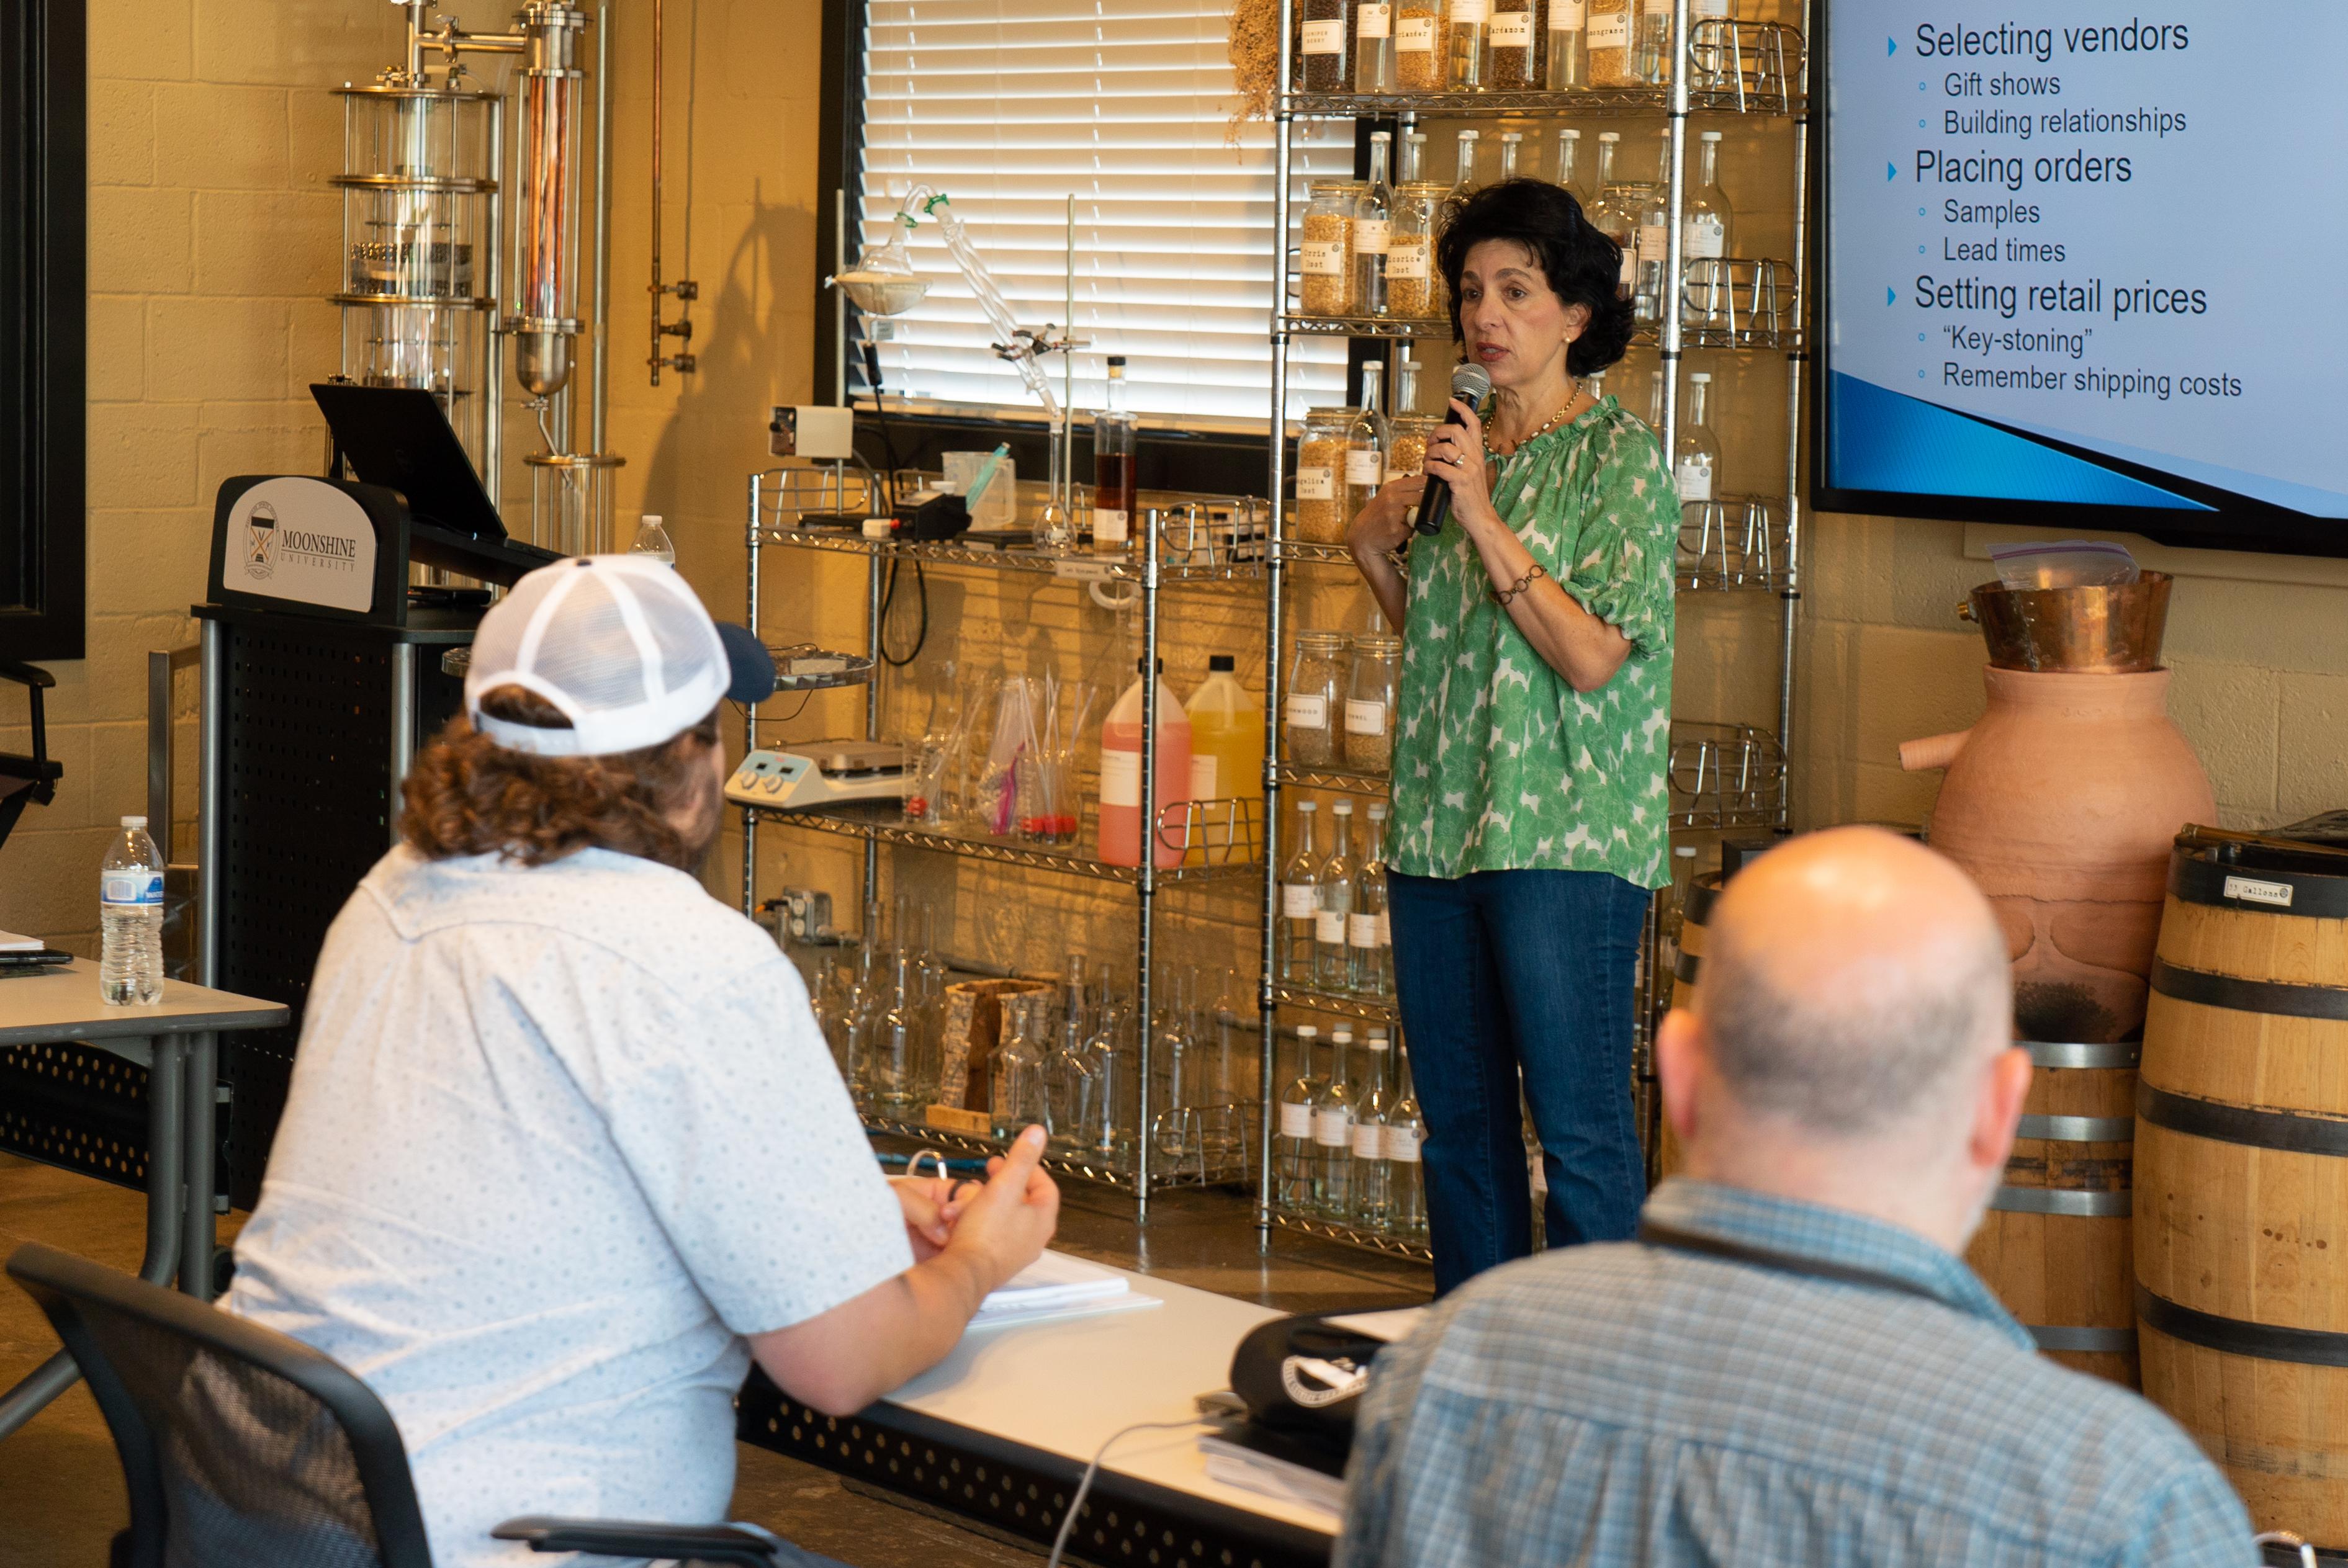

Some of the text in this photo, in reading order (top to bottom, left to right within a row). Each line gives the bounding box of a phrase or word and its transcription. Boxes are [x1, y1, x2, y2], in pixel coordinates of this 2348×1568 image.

[1916, 17, 2189, 63] Selecting vendors
[1945, 71, 2061, 97] Gift shows
[1945, 106, 2187, 140] Building relationships
[1916, 148, 2132, 192] Placing orders
[1944, 199, 2040, 230] Samples
[1944, 236, 2066, 262] Lead times
[1915, 275, 2207, 322] Setting retail prices
[1944, 361, 2242, 401] Remember shipping costs
[282, 530, 356, 557] MOONSHINE
[281, 553, 355, 572] UNIVERSITY
[2242, 885, 2278, 898] Gallons
